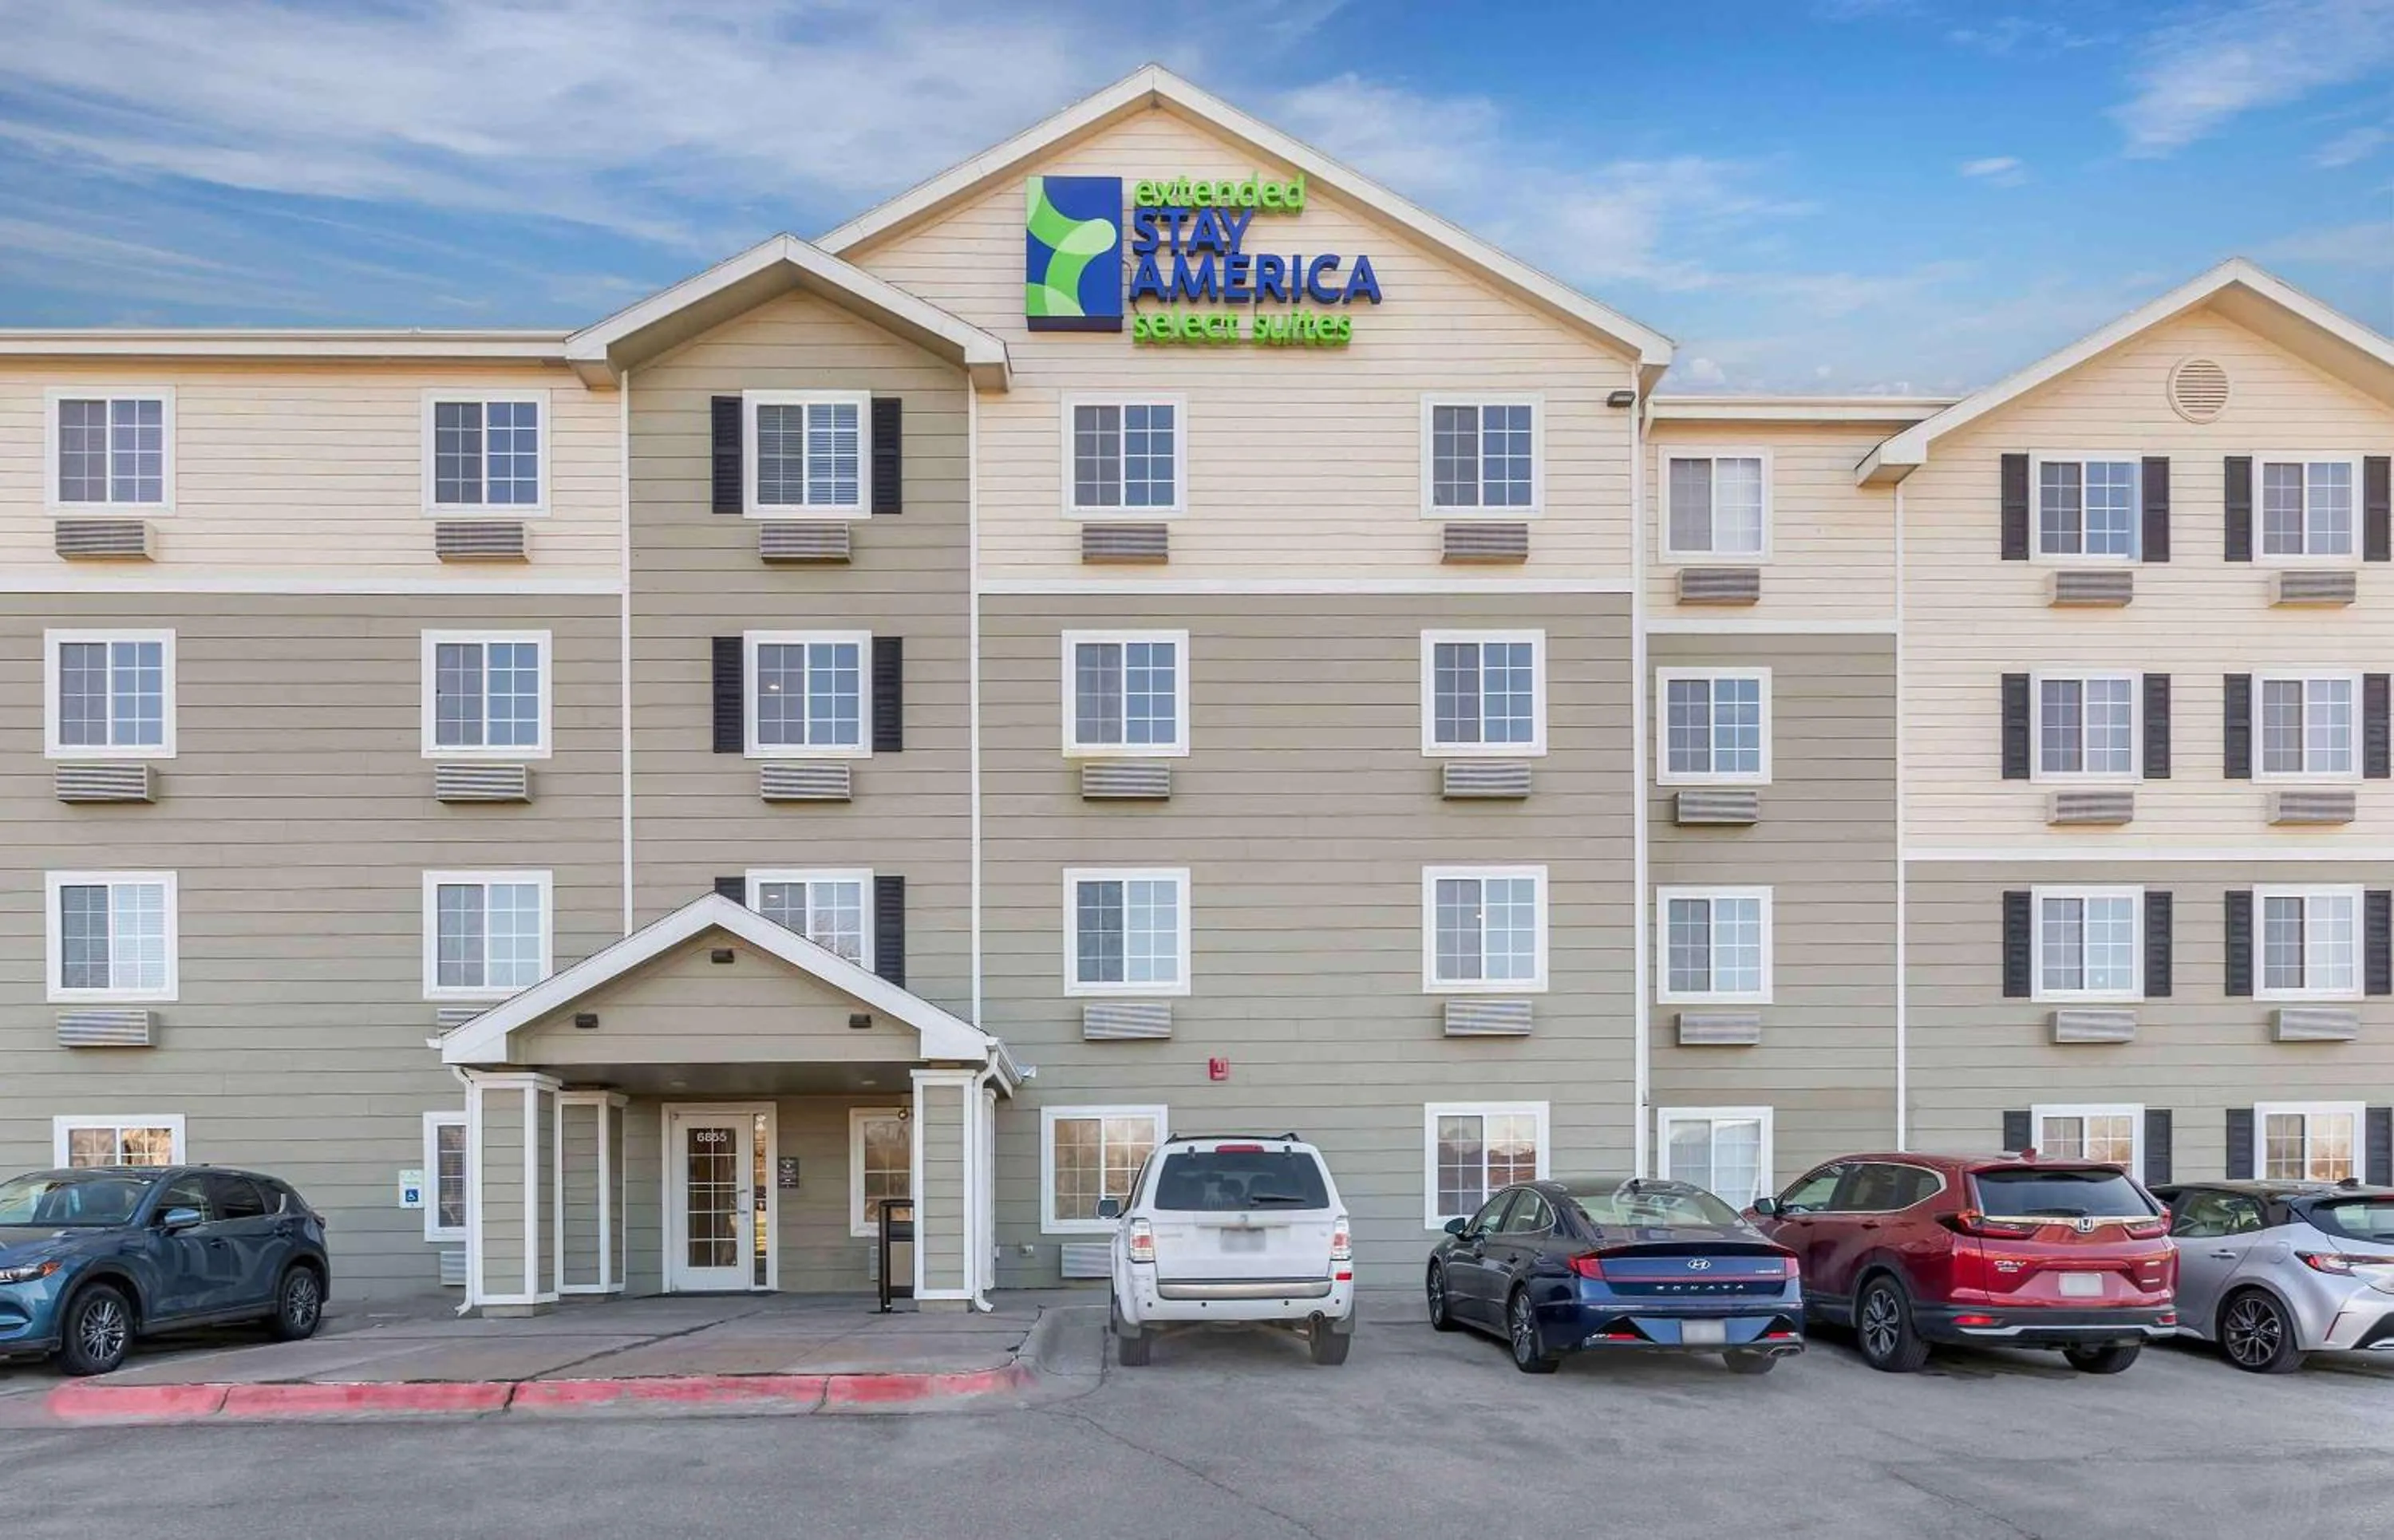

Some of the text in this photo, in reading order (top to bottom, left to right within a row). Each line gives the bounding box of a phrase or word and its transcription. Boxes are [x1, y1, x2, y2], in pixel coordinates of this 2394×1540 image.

[1134, 172, 1306, 211] extended
[1132, 206, 1254, 256] STAY
[1128, 254, 1382, 305] AMERICA
[1133, 304, 1353, 346] select suites
